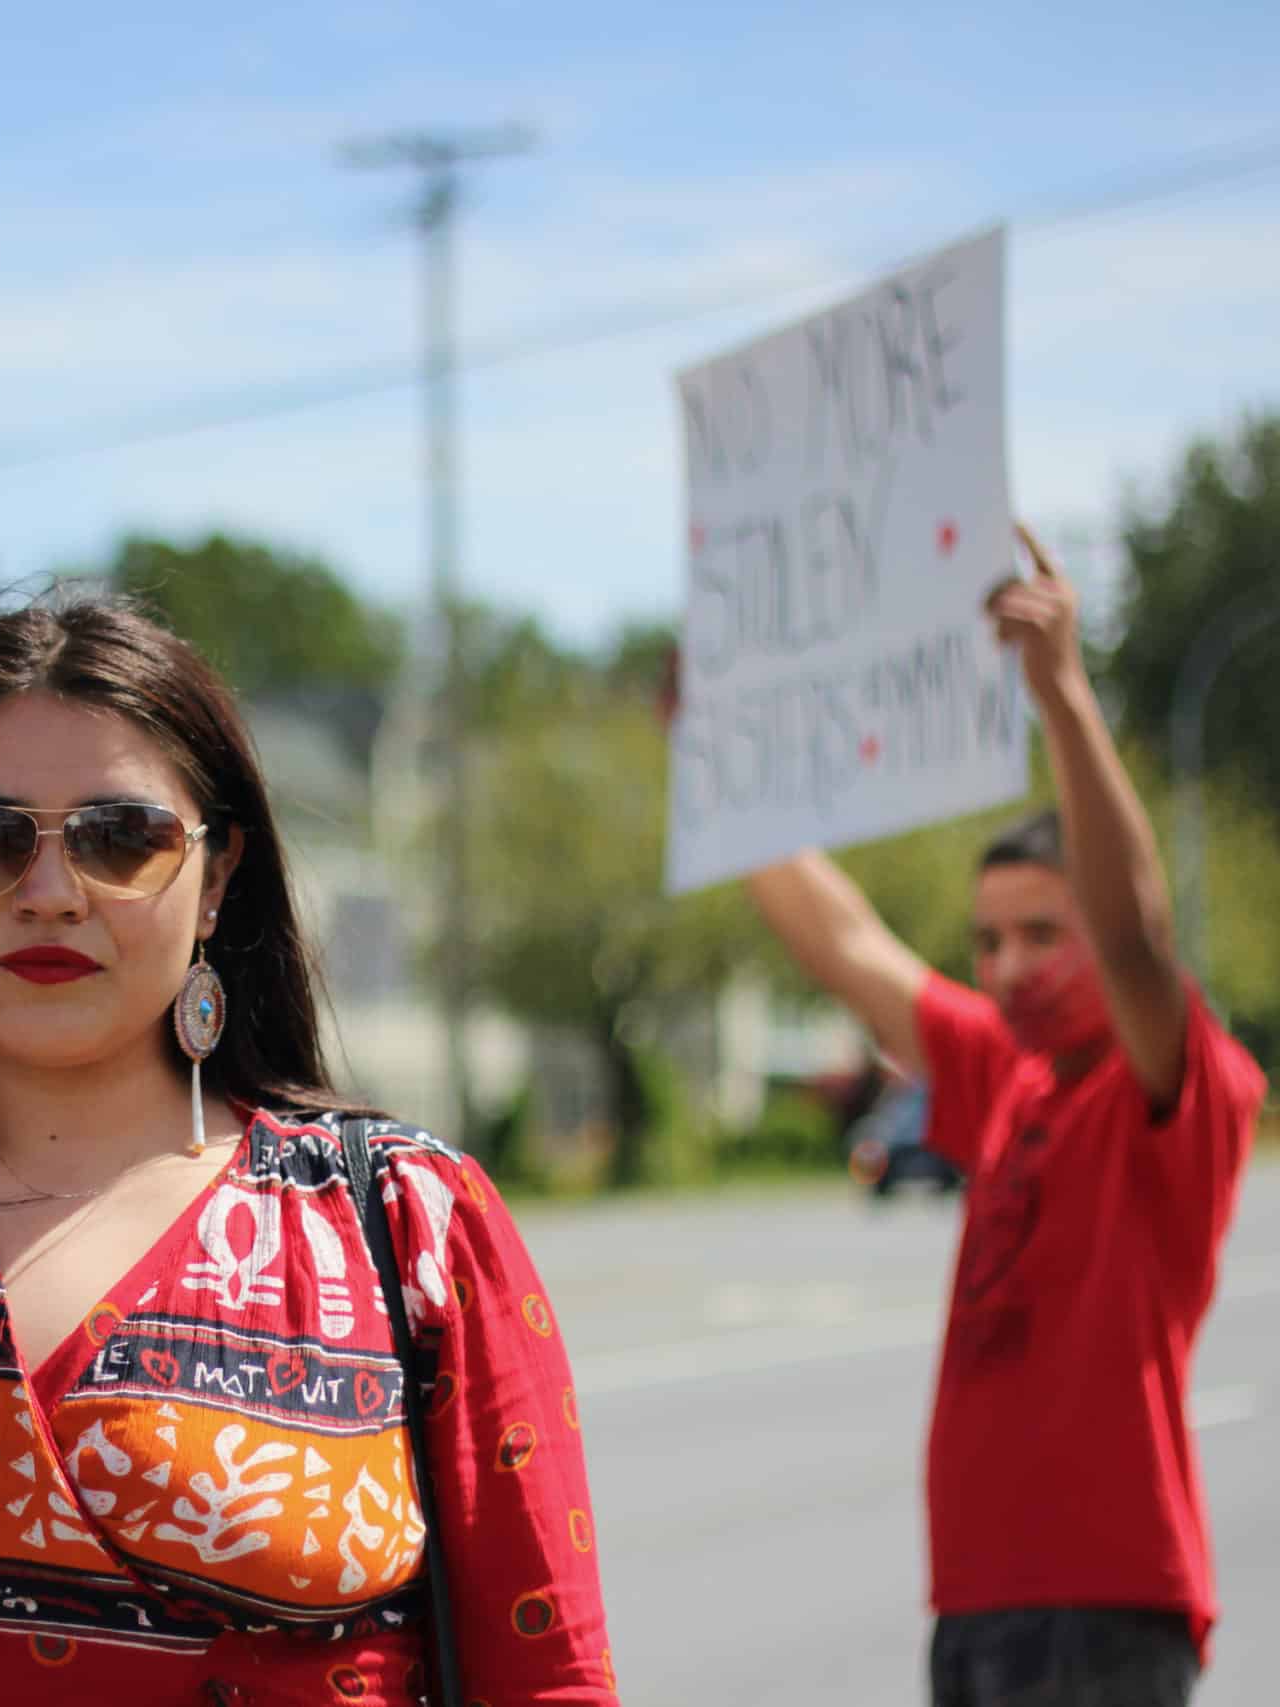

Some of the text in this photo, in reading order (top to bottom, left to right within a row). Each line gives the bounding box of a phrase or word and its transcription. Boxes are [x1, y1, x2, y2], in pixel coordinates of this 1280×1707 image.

[680, 262, 967, 480] NO MORE
[690, 455, 892, 676] STOLEN
[94, 1342, 130, 1382] LE
